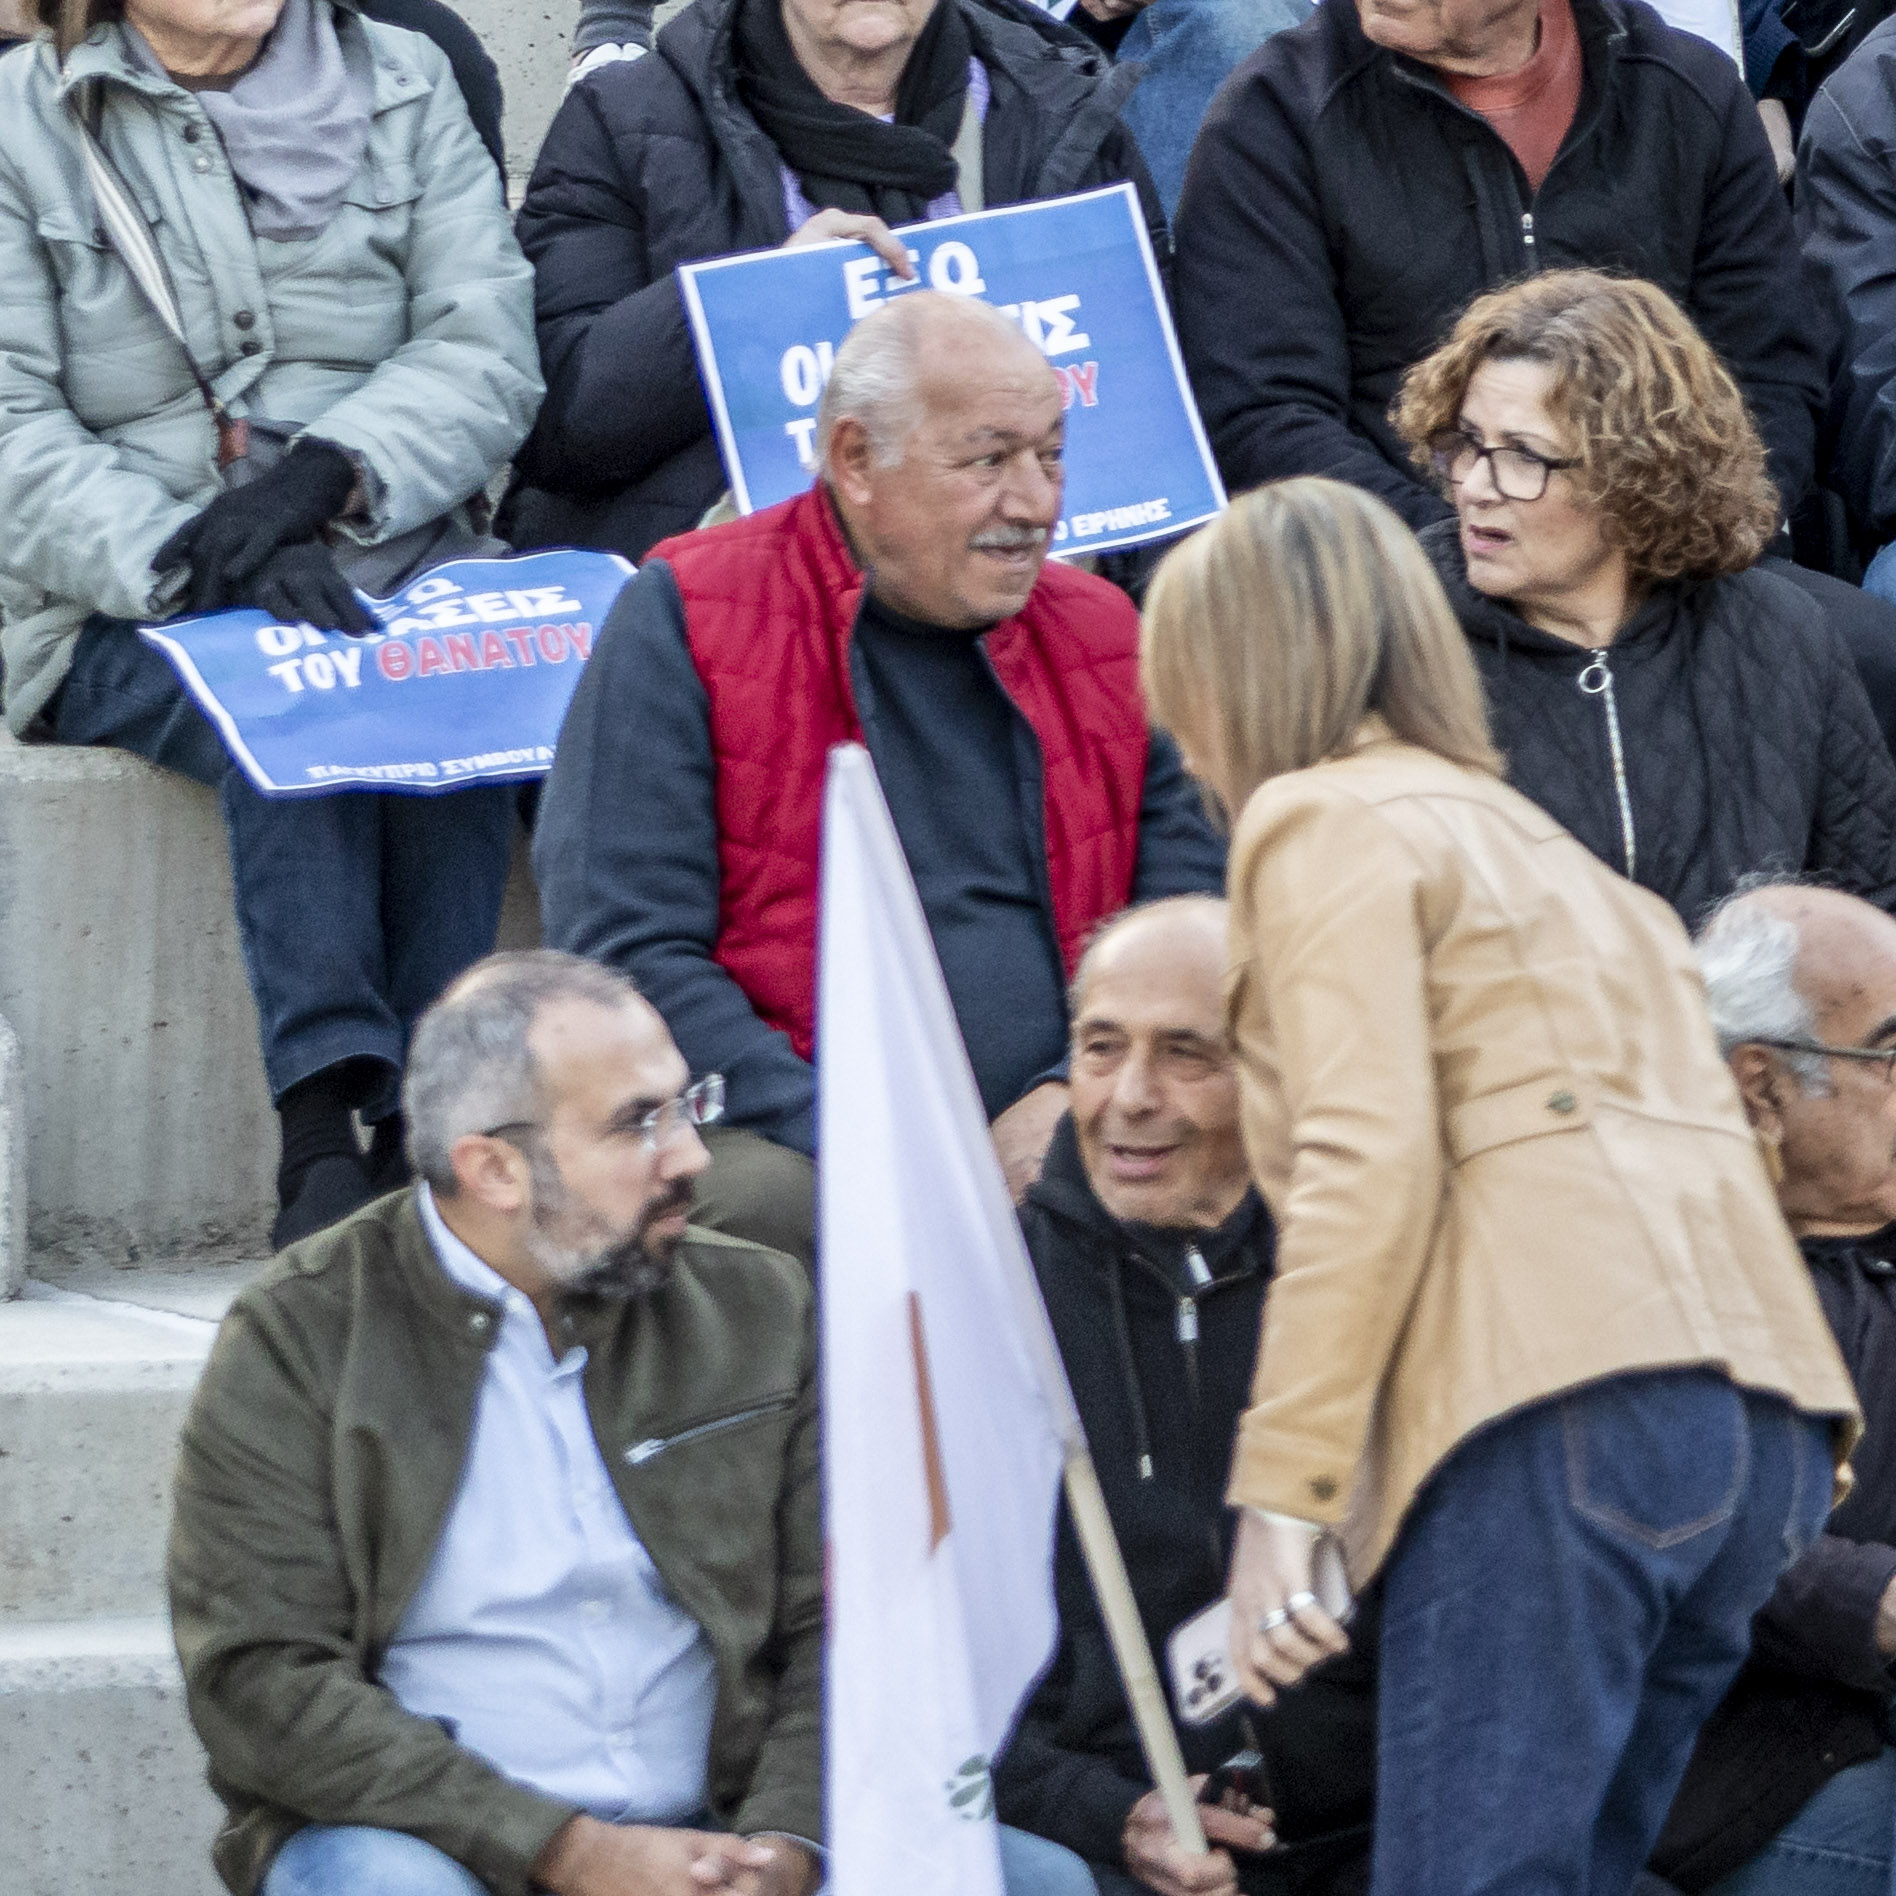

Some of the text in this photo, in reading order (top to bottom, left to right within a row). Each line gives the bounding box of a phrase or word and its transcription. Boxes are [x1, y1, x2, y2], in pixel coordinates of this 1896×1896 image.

[1073, 498, 1173, 539] ΕΙΡΗΝΗΣ
[364, 585, 583, 645] ΑΣΕΙΣ
[267, 622, 594, 694] ΤΟΥ ΘΑΝΑΤΟΥ
